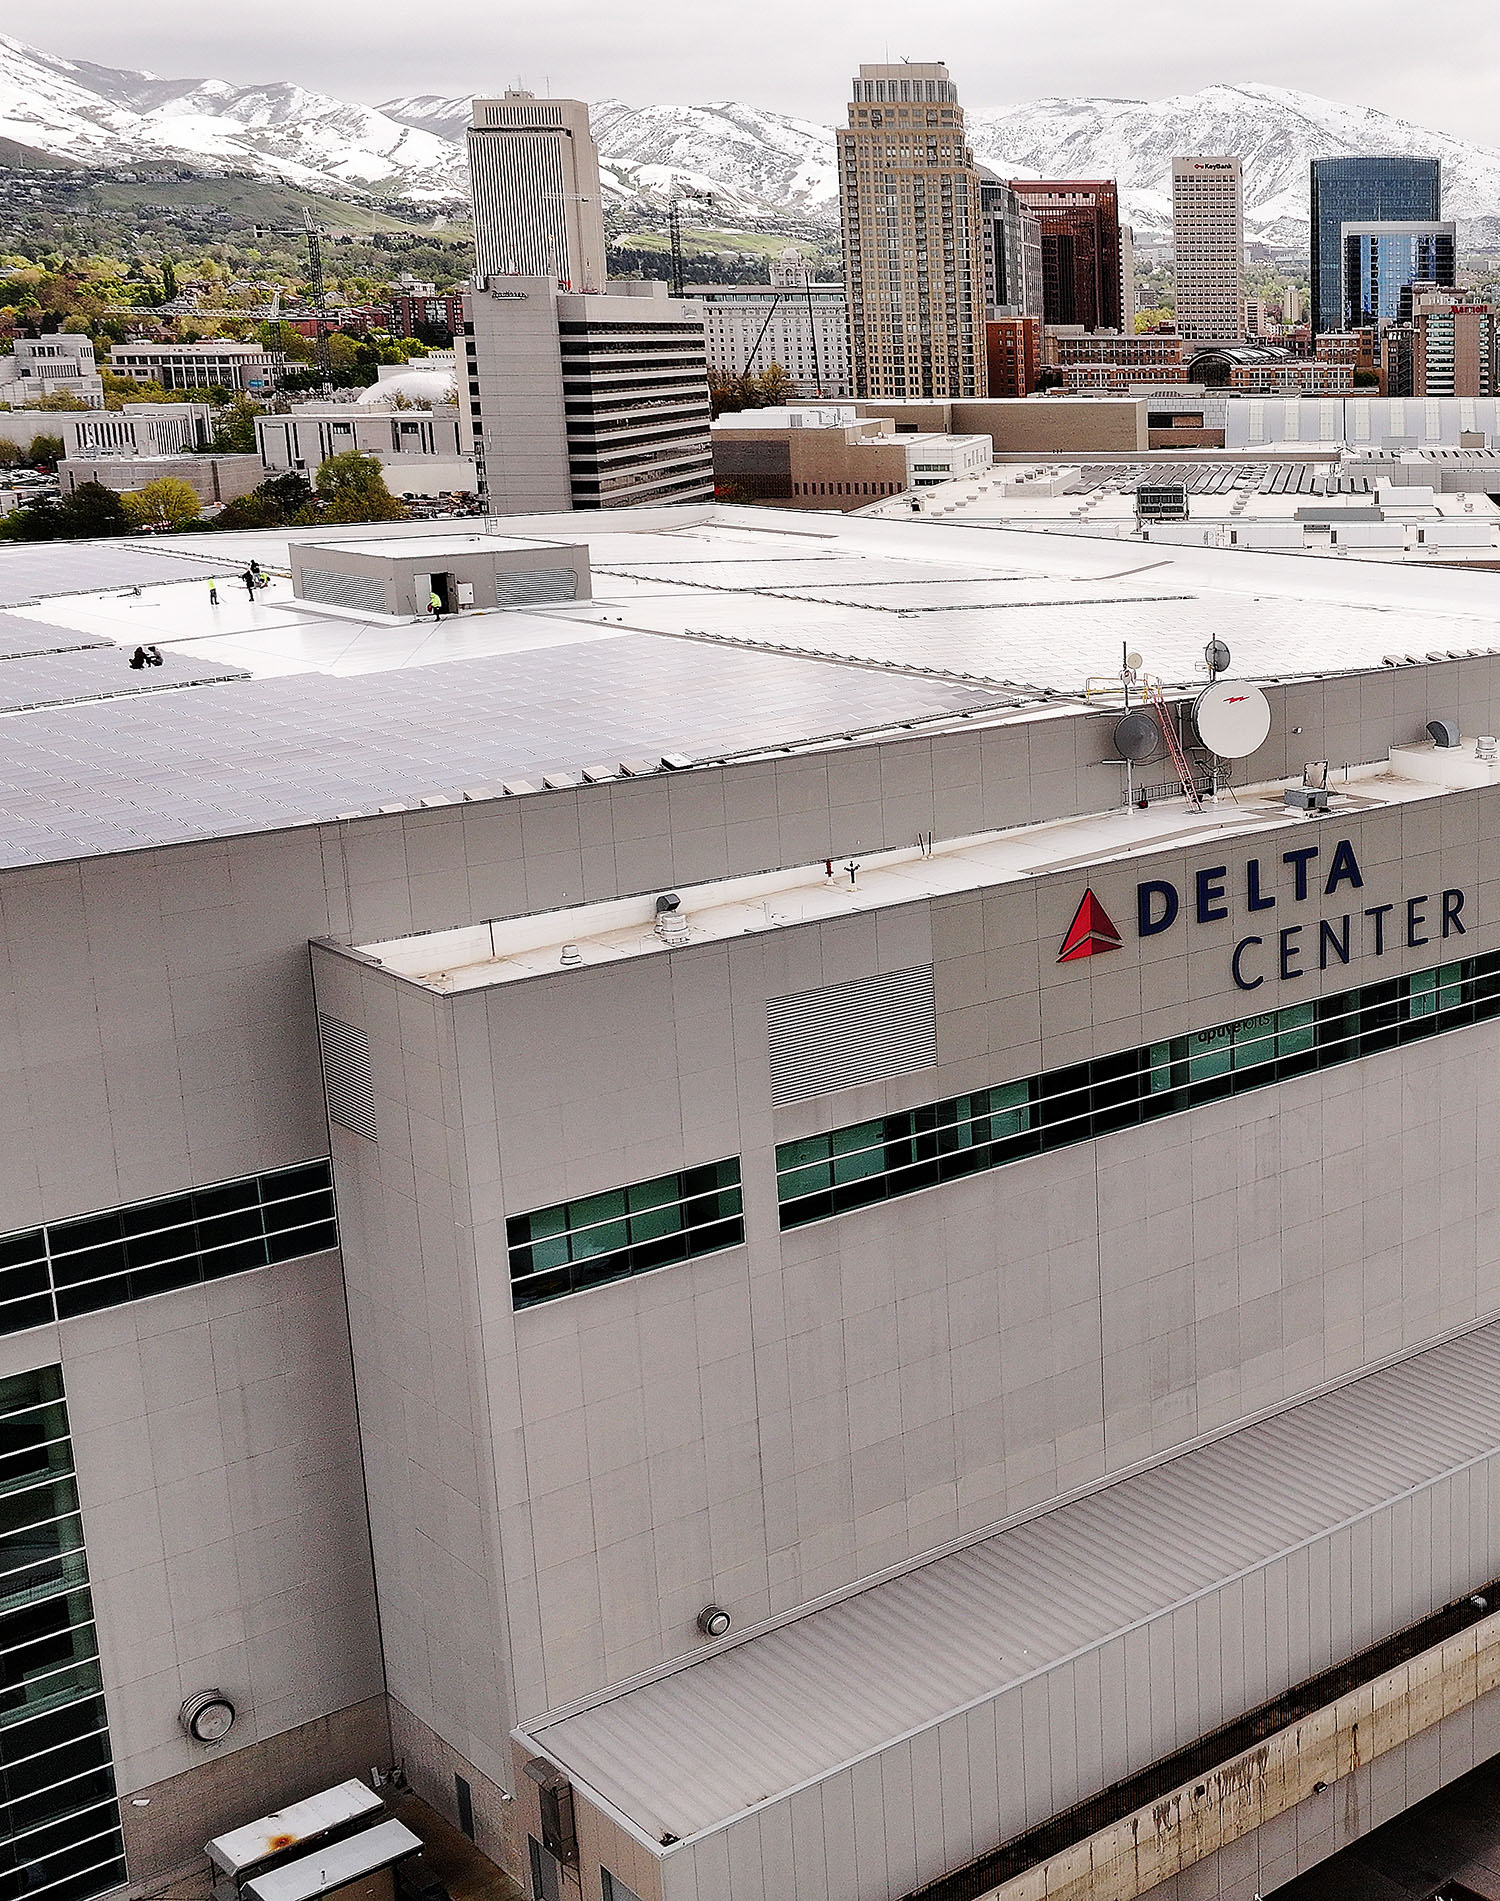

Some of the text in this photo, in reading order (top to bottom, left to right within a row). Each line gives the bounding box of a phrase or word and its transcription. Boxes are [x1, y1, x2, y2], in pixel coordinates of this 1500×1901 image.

[1449, 304, 1488, 315] Marriott
[1137, 839, 1364, 937] DELTA
[1231, 888, 1467, 990] CENTER
